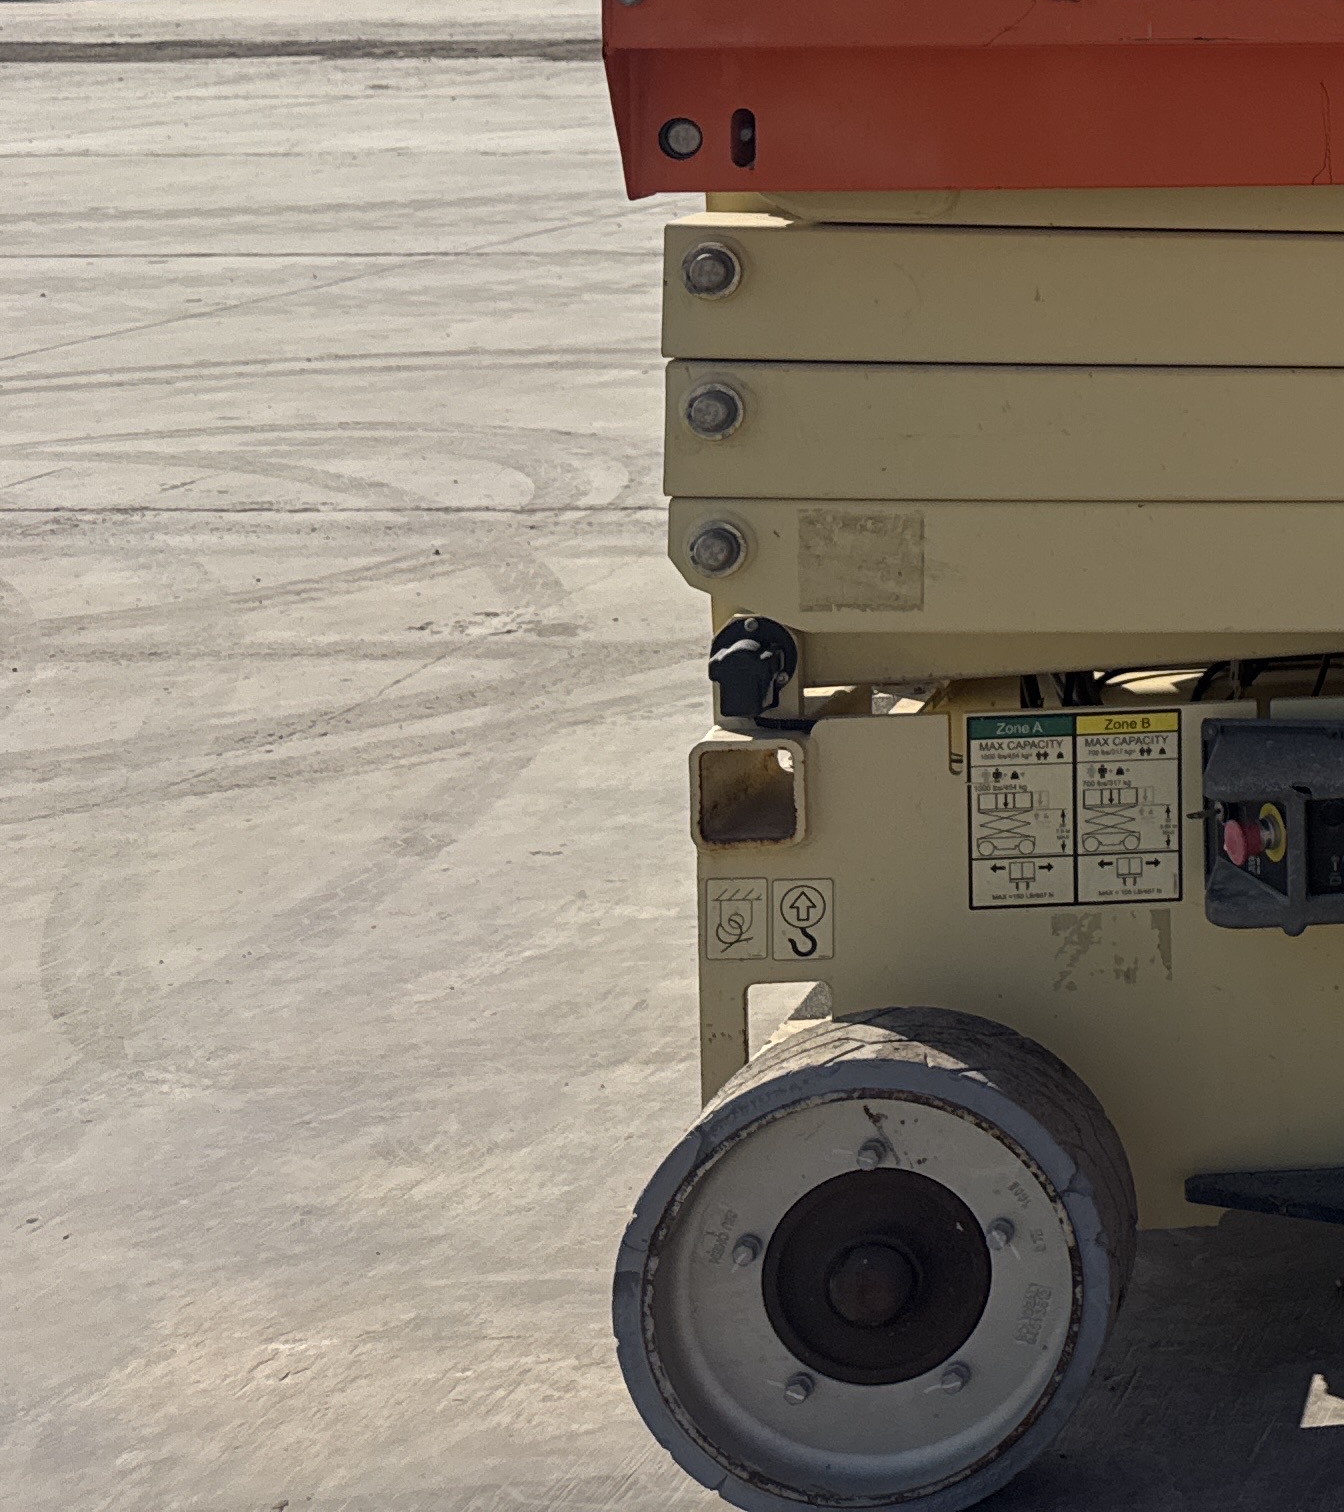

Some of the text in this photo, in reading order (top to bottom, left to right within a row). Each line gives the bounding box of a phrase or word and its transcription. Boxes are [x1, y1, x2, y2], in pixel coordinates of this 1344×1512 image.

[996, 721, 1044, 735] Zone A
[1104, 717, 1151, 730] Zone B
[979, 739, 1064, 752] MAX CAPACITY
[1084, 735, 1169, 748] MAX CAPACITY
